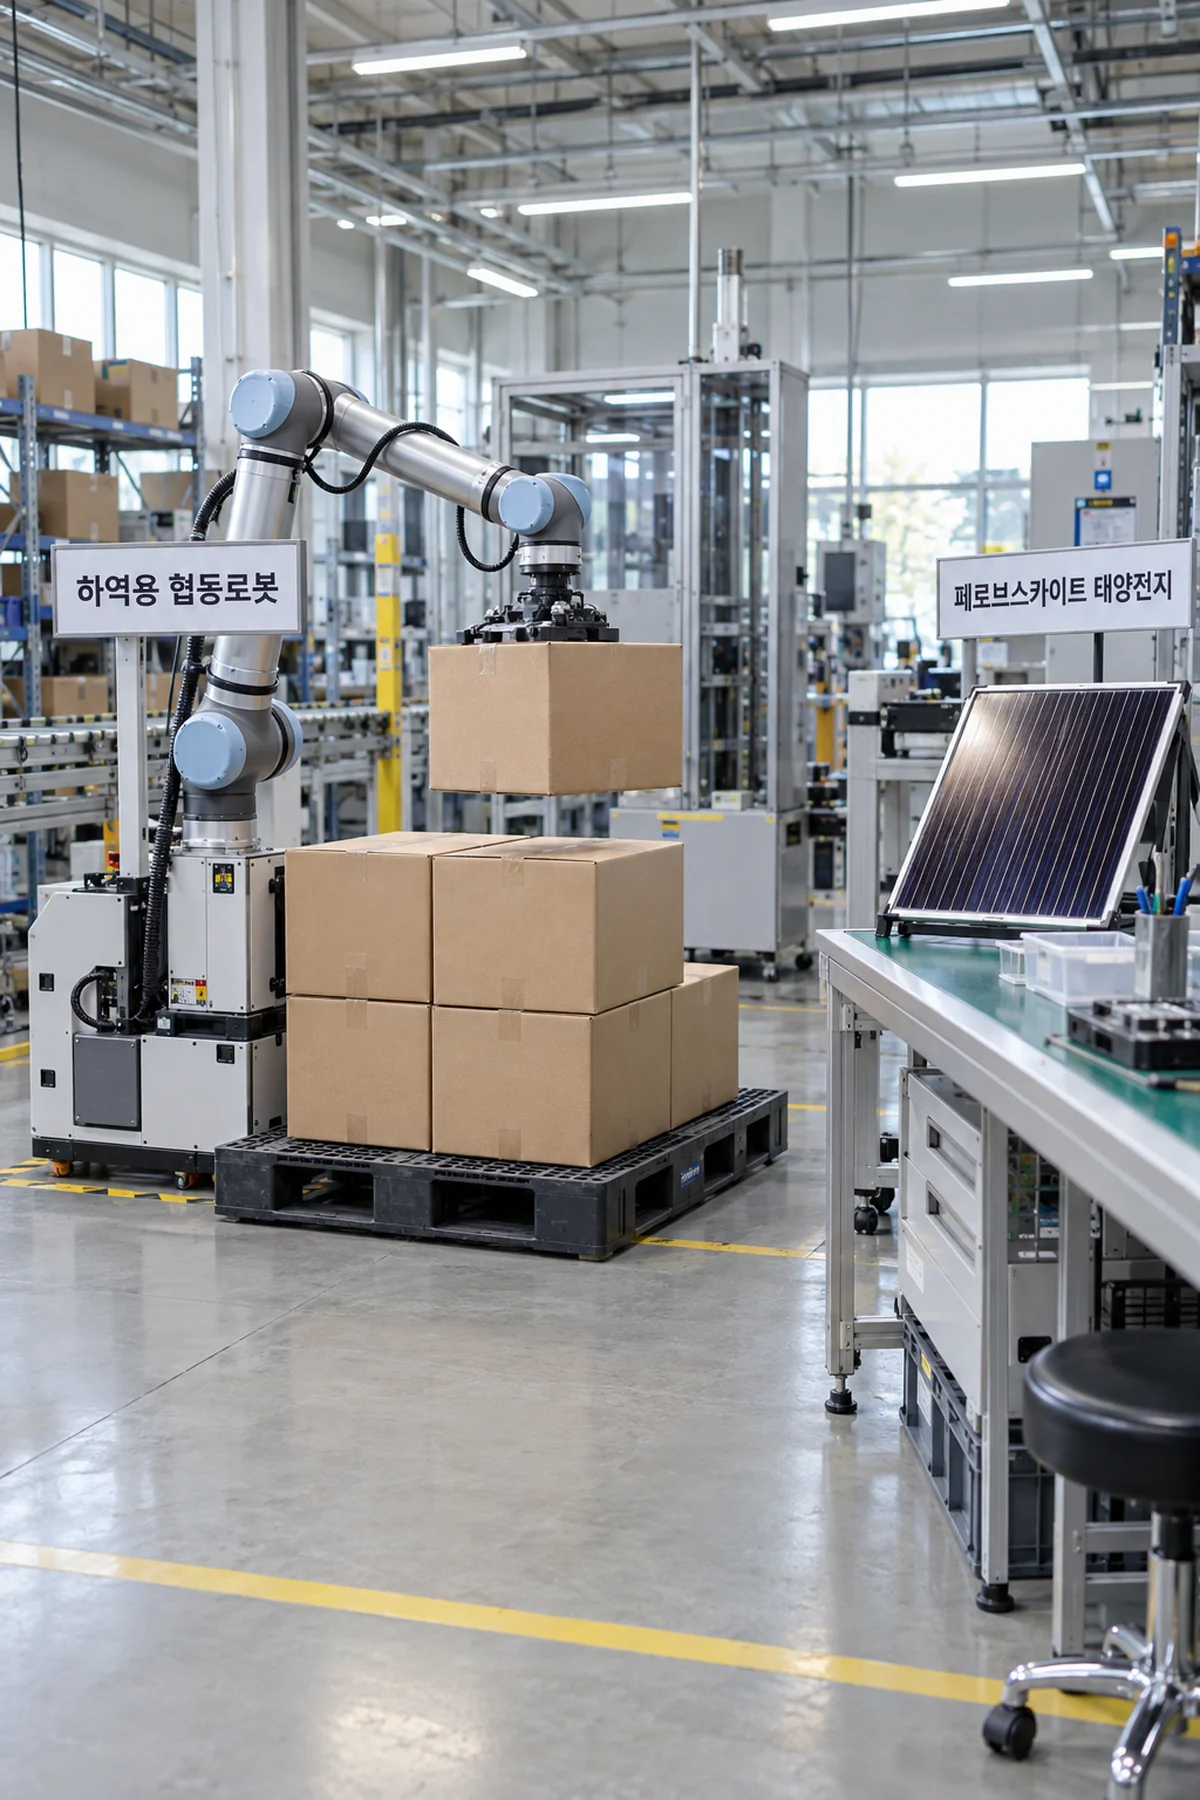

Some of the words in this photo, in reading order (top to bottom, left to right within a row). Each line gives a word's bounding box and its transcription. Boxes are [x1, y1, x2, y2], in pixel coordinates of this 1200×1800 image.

[76, 574, 160, 608] 하역용
[168, 572, 279, 606] 협동로봇
[954, 576, 1087, 612] 페로브스카이트
[1094, 570, 1172, 604] 태양전지
